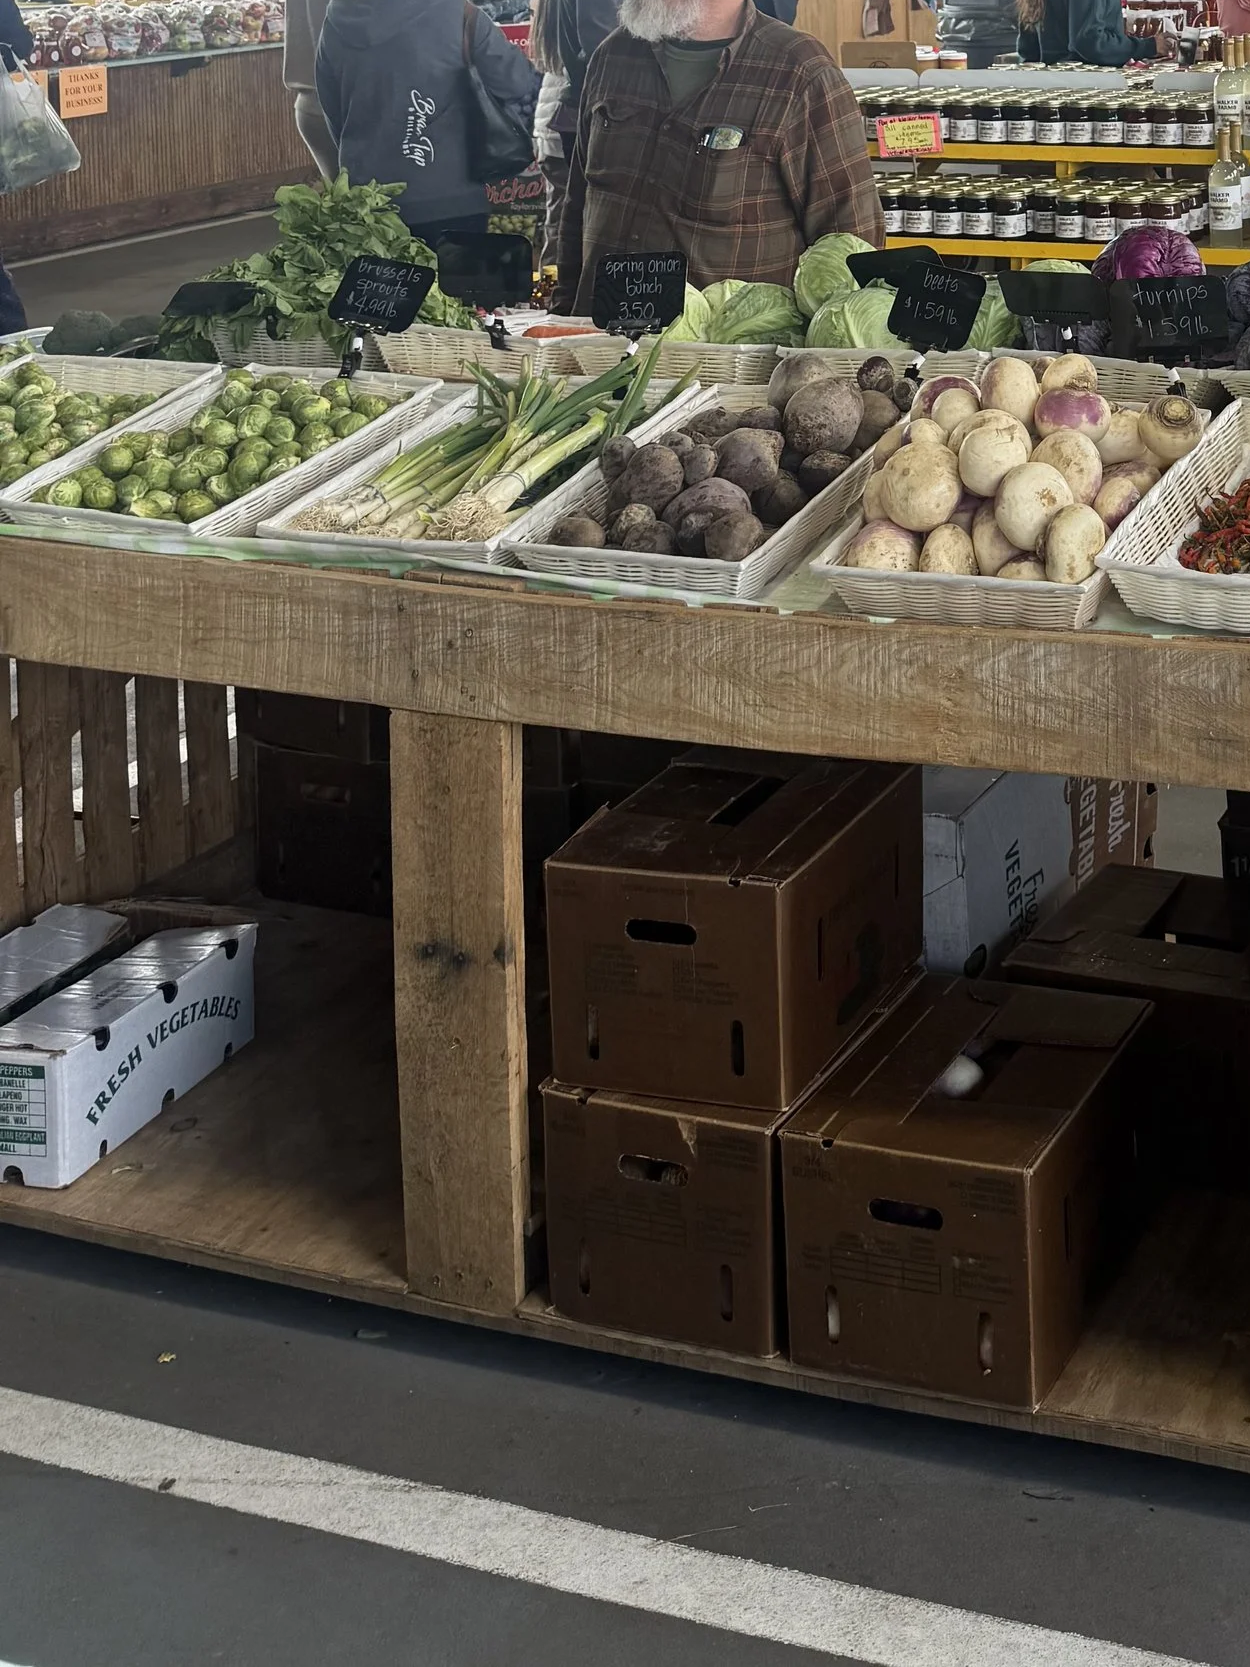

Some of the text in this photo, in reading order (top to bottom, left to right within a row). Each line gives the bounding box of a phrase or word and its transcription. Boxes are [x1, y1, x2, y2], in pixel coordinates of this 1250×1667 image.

[68, 71, 99, 83] THANKS
[64, 84, 103, 96] FOR YOUR
[357, 257, 422, 283] brussels
[605, 258, 681, 284] spring onion
[923, 268, 959, 293] beets
[356, 276, 409, 299] sprouts
[625, 277, 663, 296] bunch
[1132, 283, 1209, 310] turnips
[618, 301, 655, 320] 3.50
[85, 995, 242, 1127] FRESH VEGETABLES
[15, 1103, 28, 1113] HOT
[13, 1116, 28, 1125] WAX
